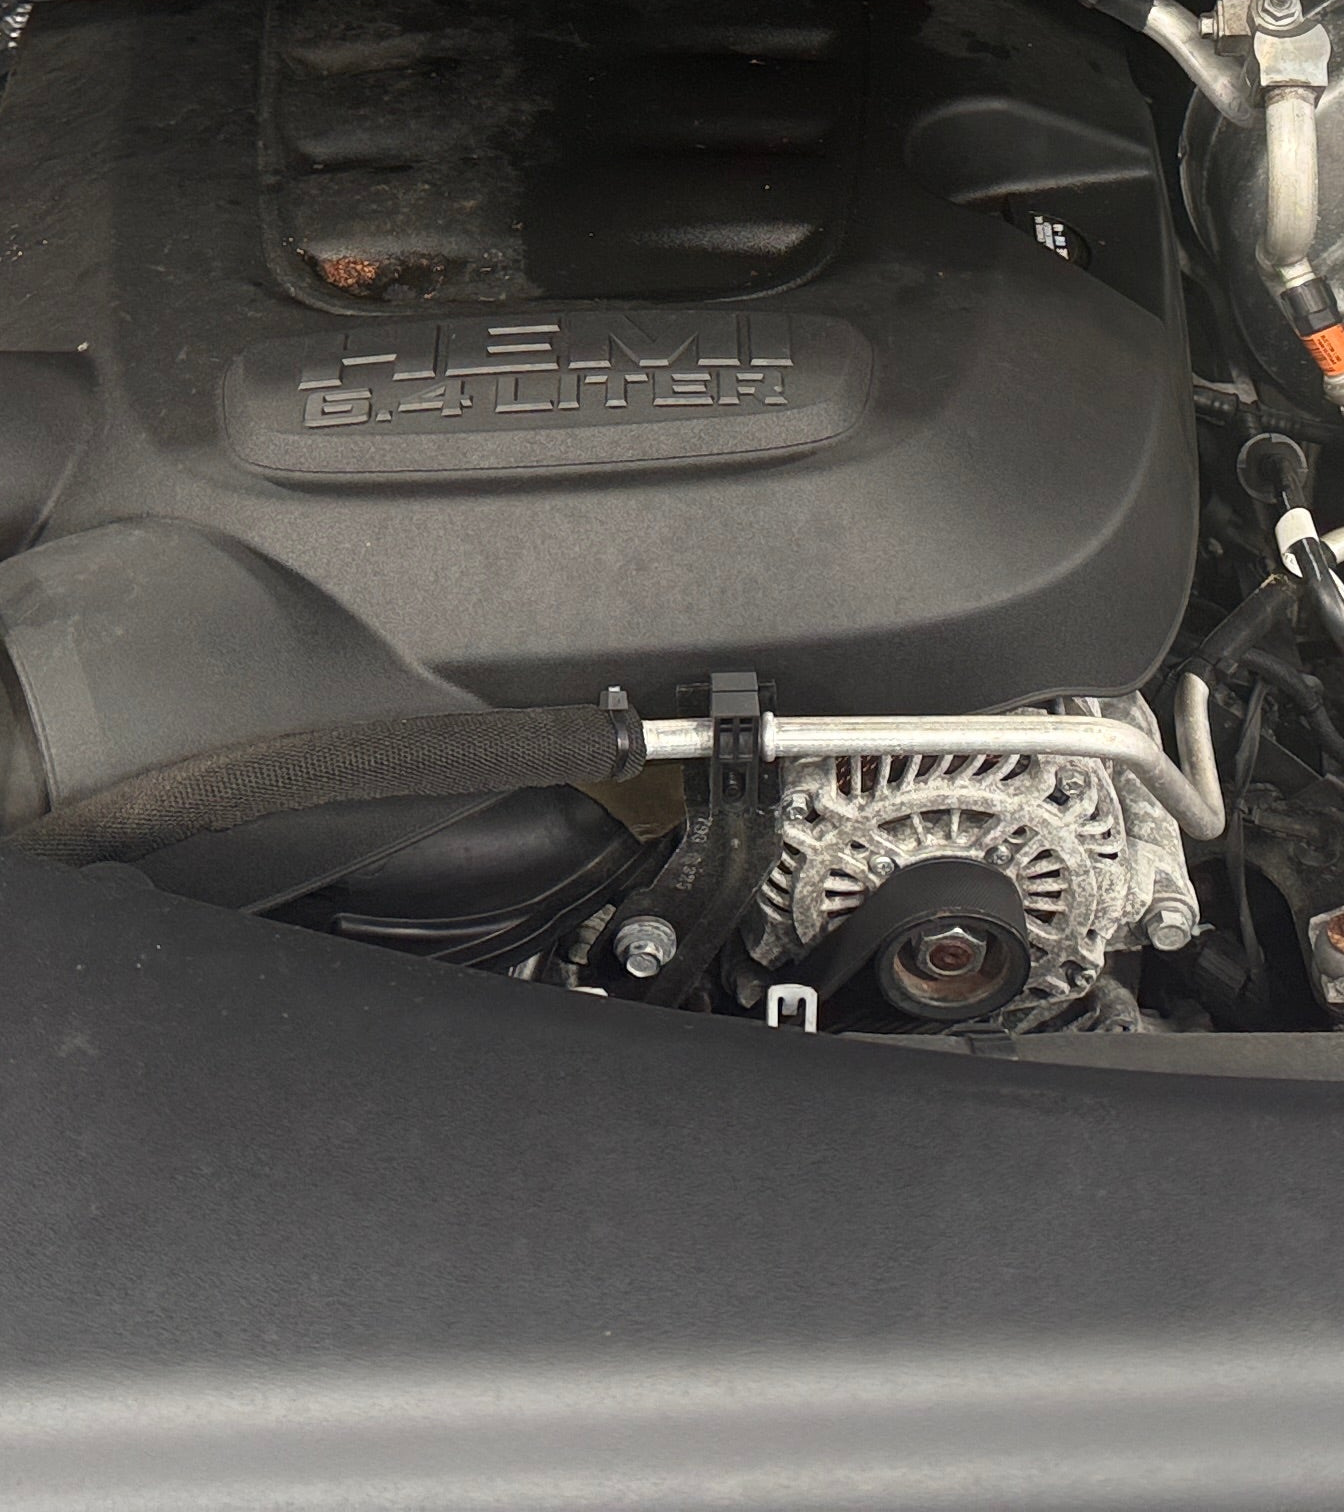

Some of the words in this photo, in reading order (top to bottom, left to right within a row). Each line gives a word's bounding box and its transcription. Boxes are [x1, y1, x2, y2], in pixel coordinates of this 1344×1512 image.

[297, 312, 794, 391] HEMI
[303, 379, 474, 429] 6.4
[494, 371, 789, 414] LITER
